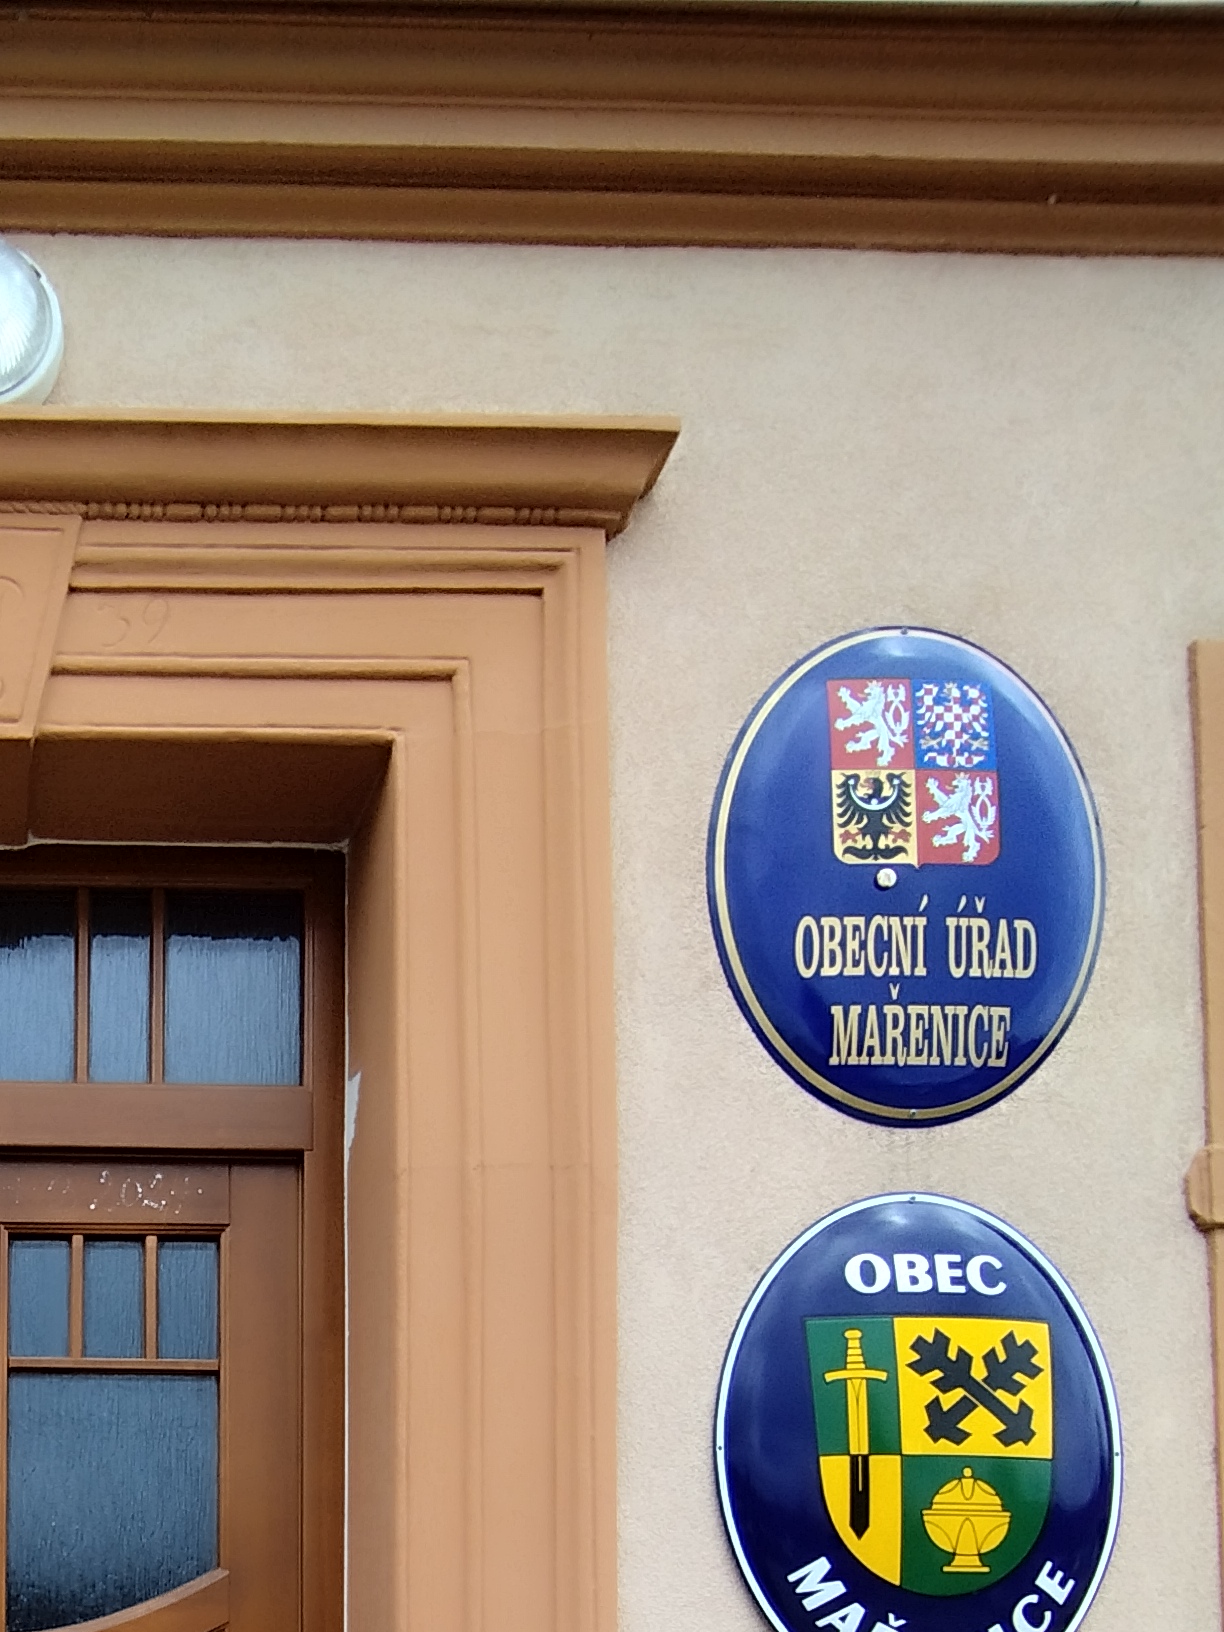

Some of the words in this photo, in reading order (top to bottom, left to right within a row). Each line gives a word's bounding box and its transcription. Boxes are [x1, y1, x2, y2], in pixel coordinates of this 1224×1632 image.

[794, 894, 929, 979] OBECNÍ
[945, 895, 1038, 979] ÚŘAD
[828, 983, 1012, 1068] MAŘENICE
[844, 1253, 1008, 1296] OBEC
